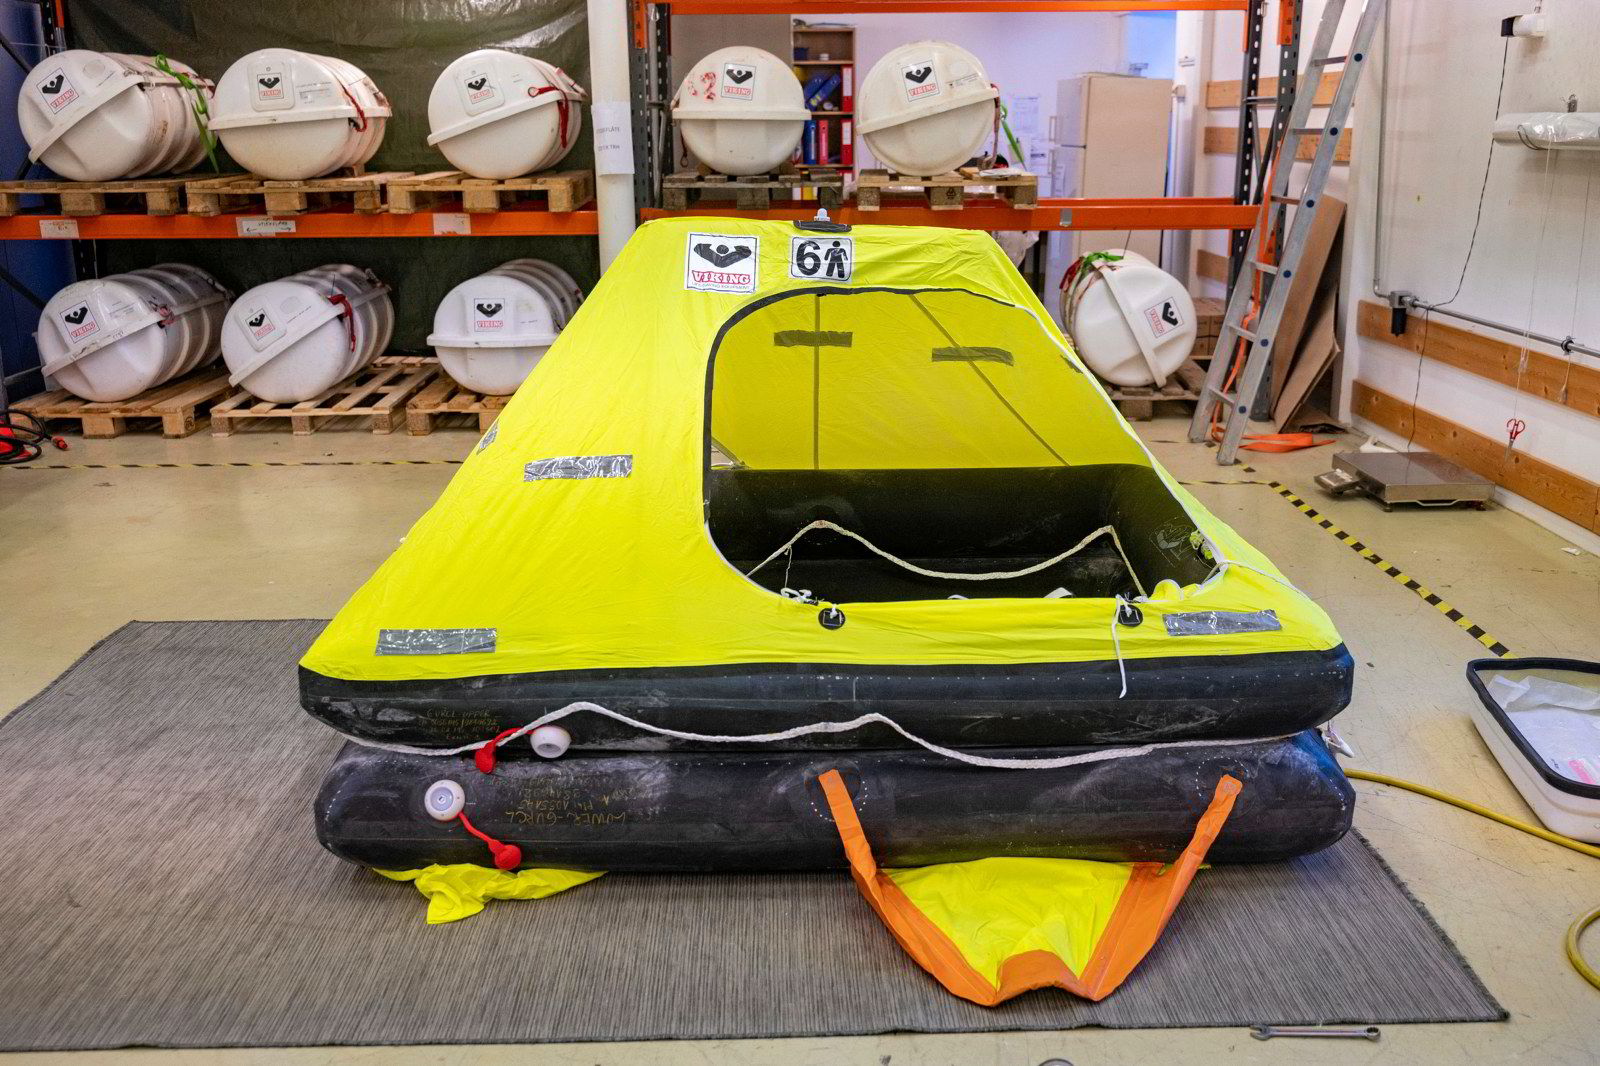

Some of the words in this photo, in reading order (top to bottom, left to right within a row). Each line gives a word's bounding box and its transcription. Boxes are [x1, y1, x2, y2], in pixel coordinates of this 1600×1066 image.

[260, 89, 281, 97] VIKING
[470, 88, 491, 100] VIKING
[723, 85, 751, 96] VIKING
[908, 83, 937, 97] VIKING
[50, 88, 75, 109] VIKING
[796, 240, 821, 276] 6
[691, 270, 751, 285] VIKING
[476, 320, 503, 328] VIKING
[1150, 308, 1165, 334] VIKING
[71, 321, 96, 338] VIKING
[255, 323, 274, 337] VIKING
